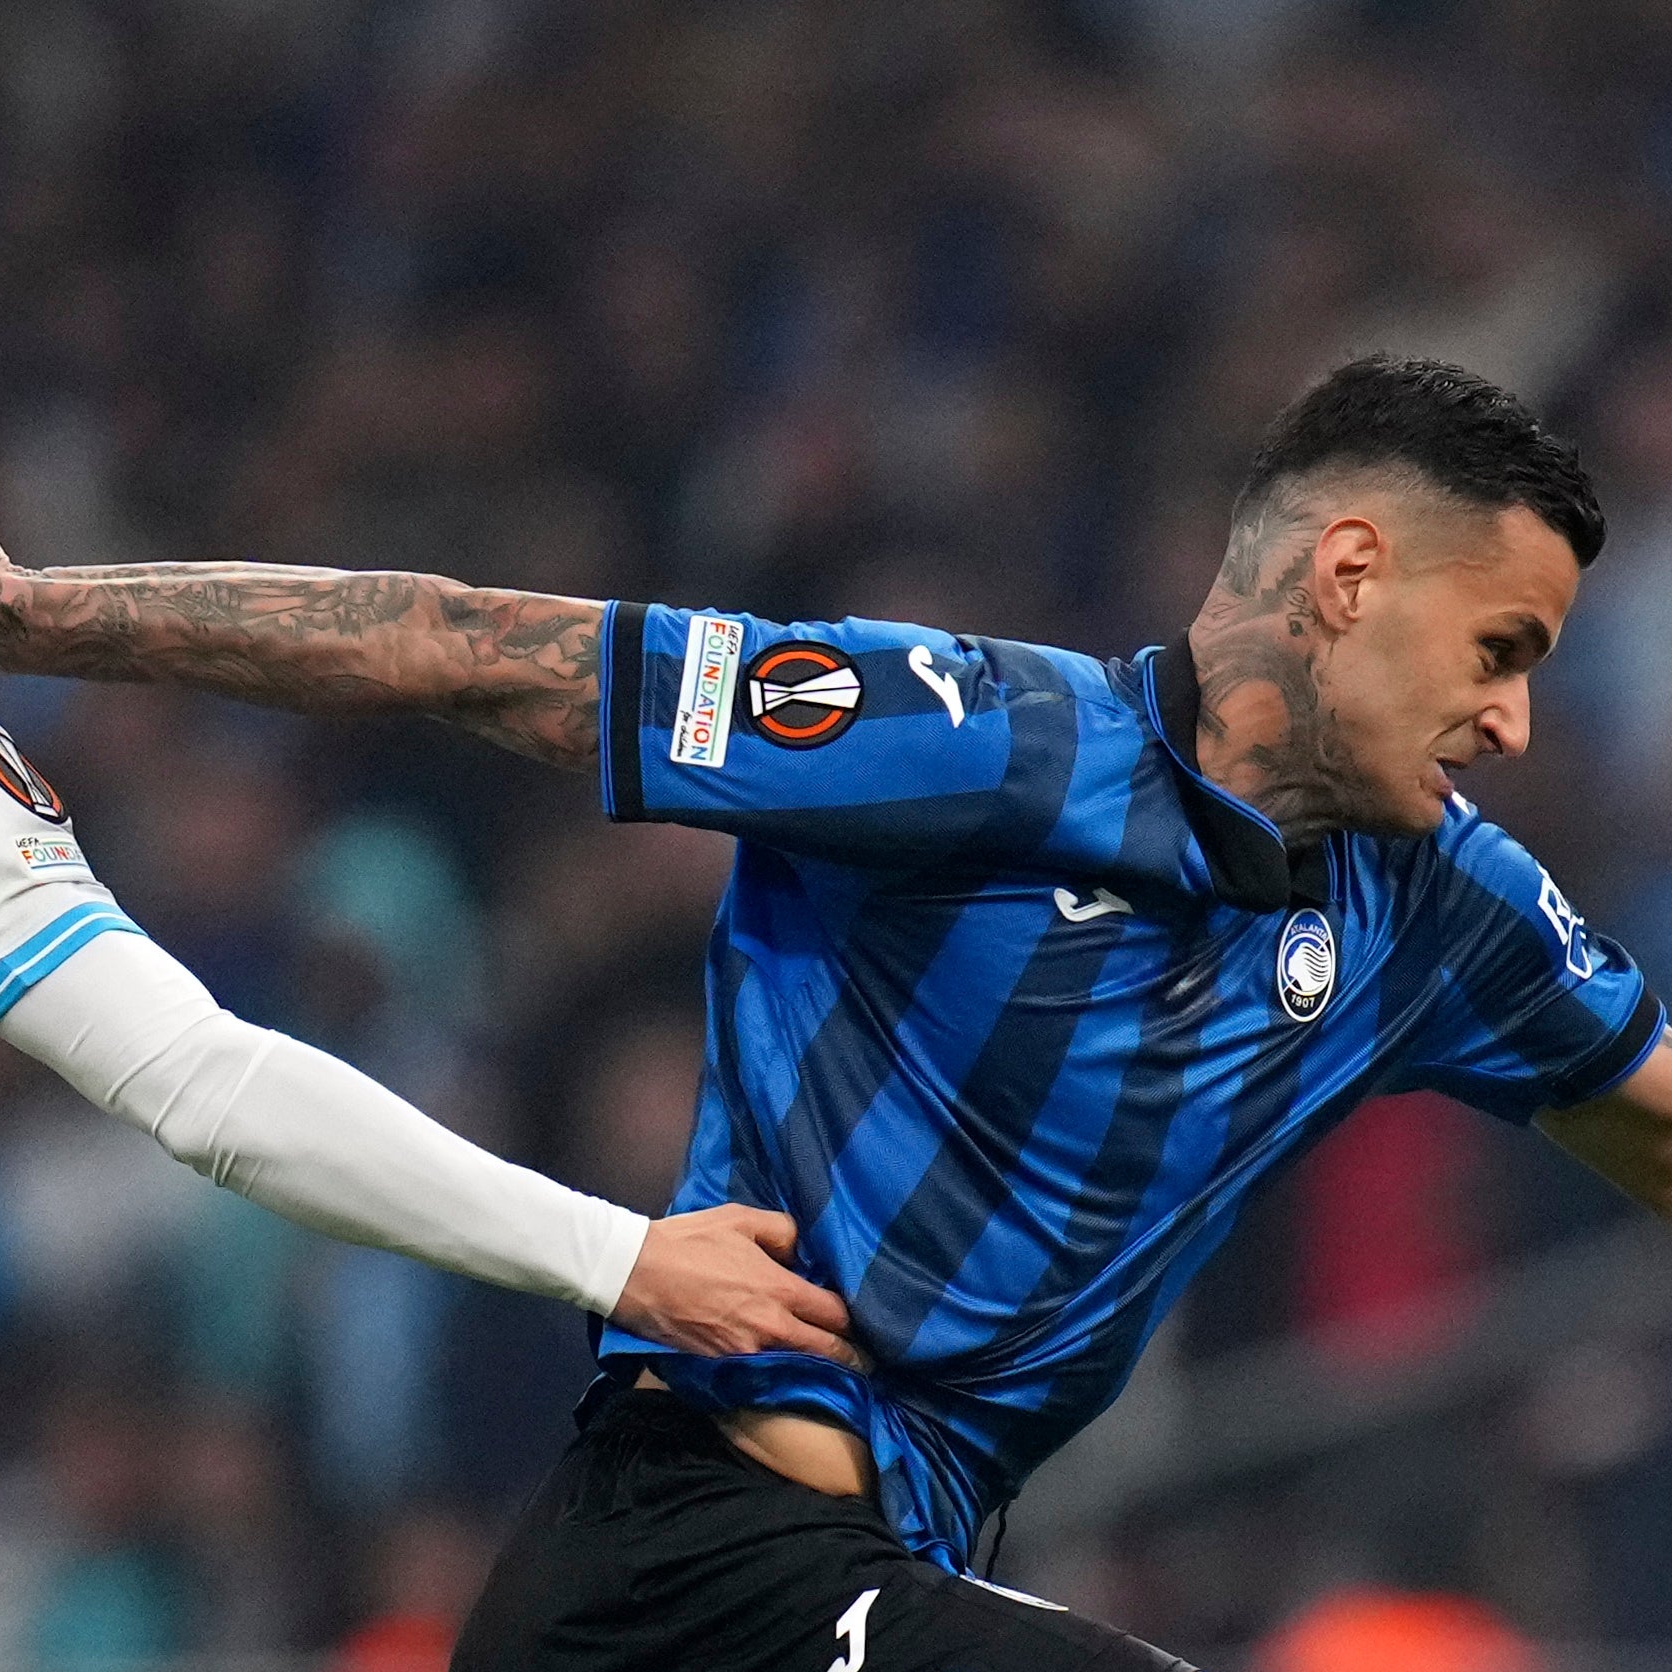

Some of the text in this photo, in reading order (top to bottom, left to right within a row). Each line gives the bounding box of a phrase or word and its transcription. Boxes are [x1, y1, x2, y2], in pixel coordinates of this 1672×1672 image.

[726, 625, 740, 656] UEFA
[690, 621, 727, 761] FOUNDATION
[15, 836, 40, 848] UEFA
[1290, 923, 1327, 940] ATALANTA
[1291, 993, 1315, 1009] 1907
